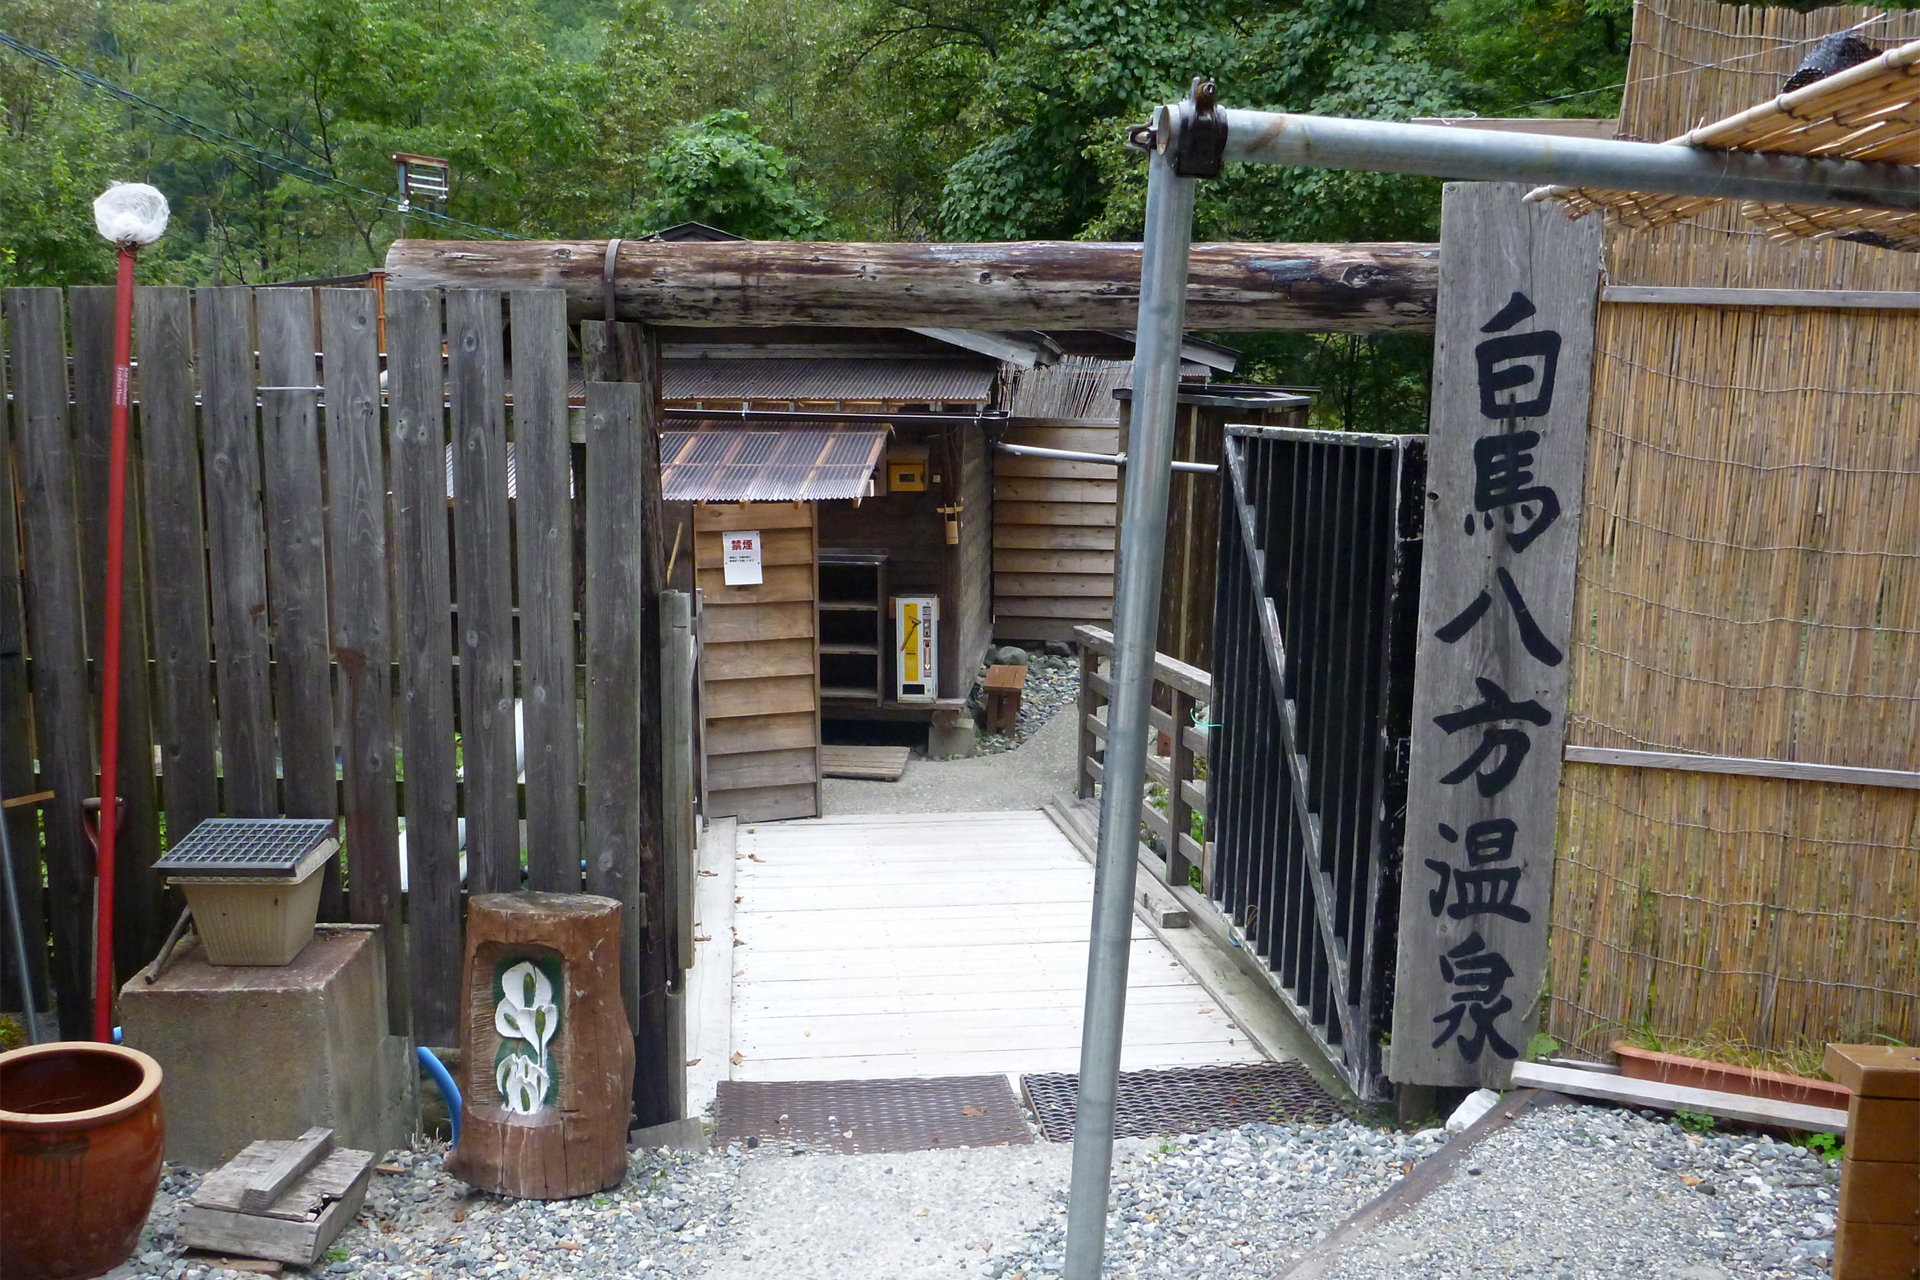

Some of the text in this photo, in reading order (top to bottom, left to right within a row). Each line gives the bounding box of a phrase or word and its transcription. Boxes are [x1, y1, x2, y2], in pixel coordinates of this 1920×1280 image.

[731, 539, 753, 551] 禁煙
[1425, 291, 1563, 1064] 白馬八方温泉
